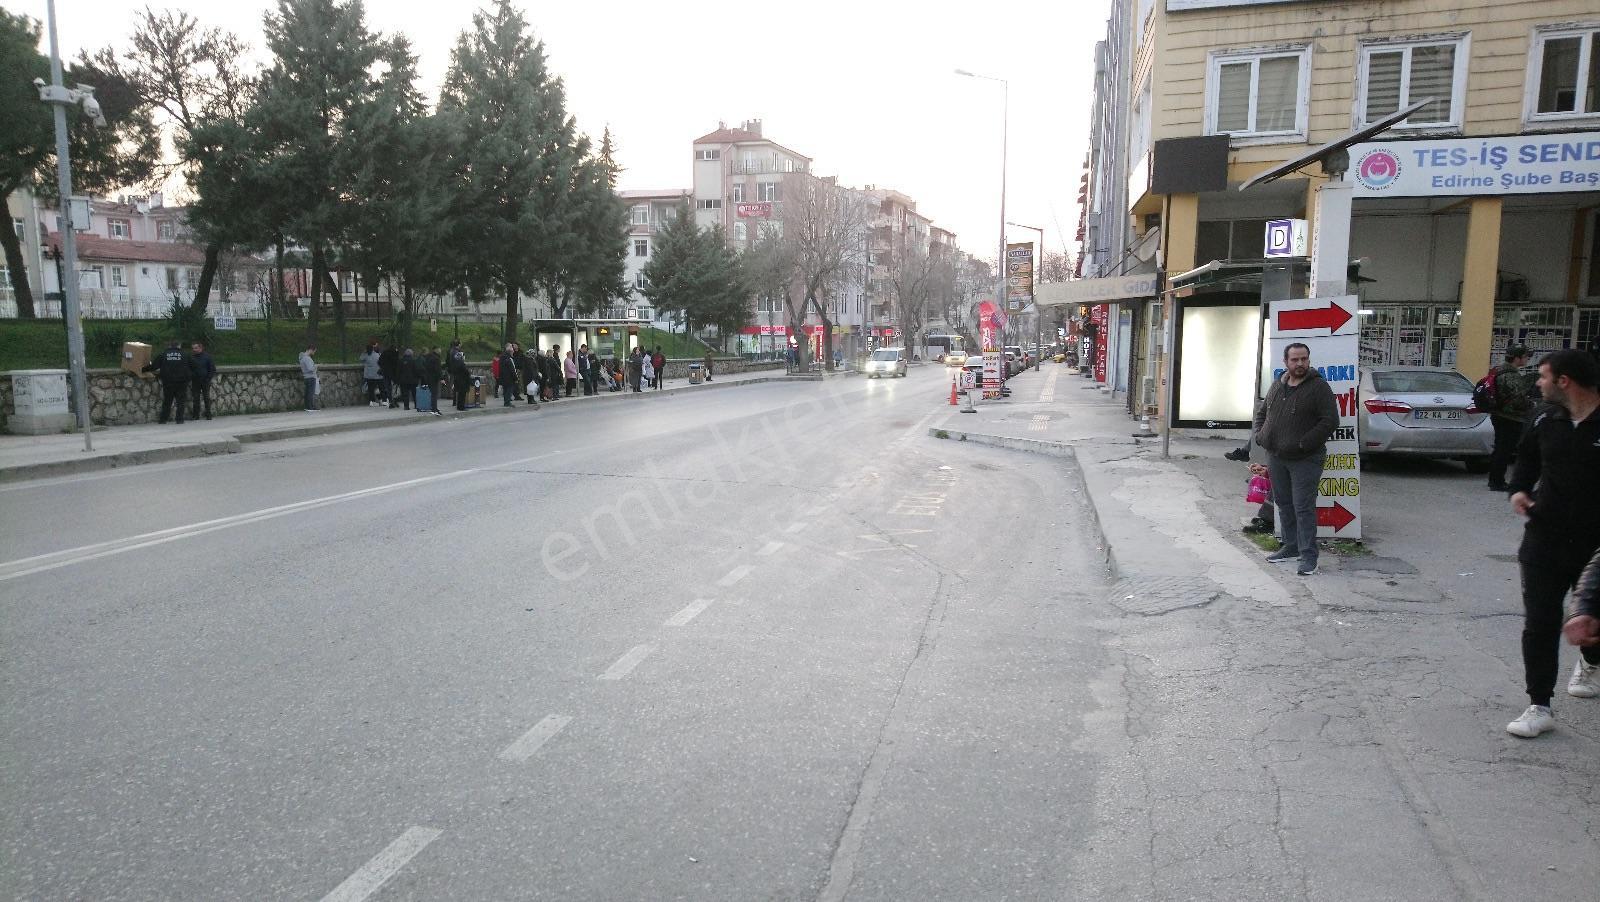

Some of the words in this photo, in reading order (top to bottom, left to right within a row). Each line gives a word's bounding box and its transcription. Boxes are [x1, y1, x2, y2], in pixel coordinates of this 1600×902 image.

[1413, 141, 1508, 170] TES-İŞ
[1518, 141, 1600, 164] SEND
[1432, 173, 1494, 188] Edirne
[1501, 170, 1552, 189] Şube
[1559, 169, 1599, 185] Baş
[1274, 229, 1285, 247] D
[1316, 477, 1360, 497] KING
